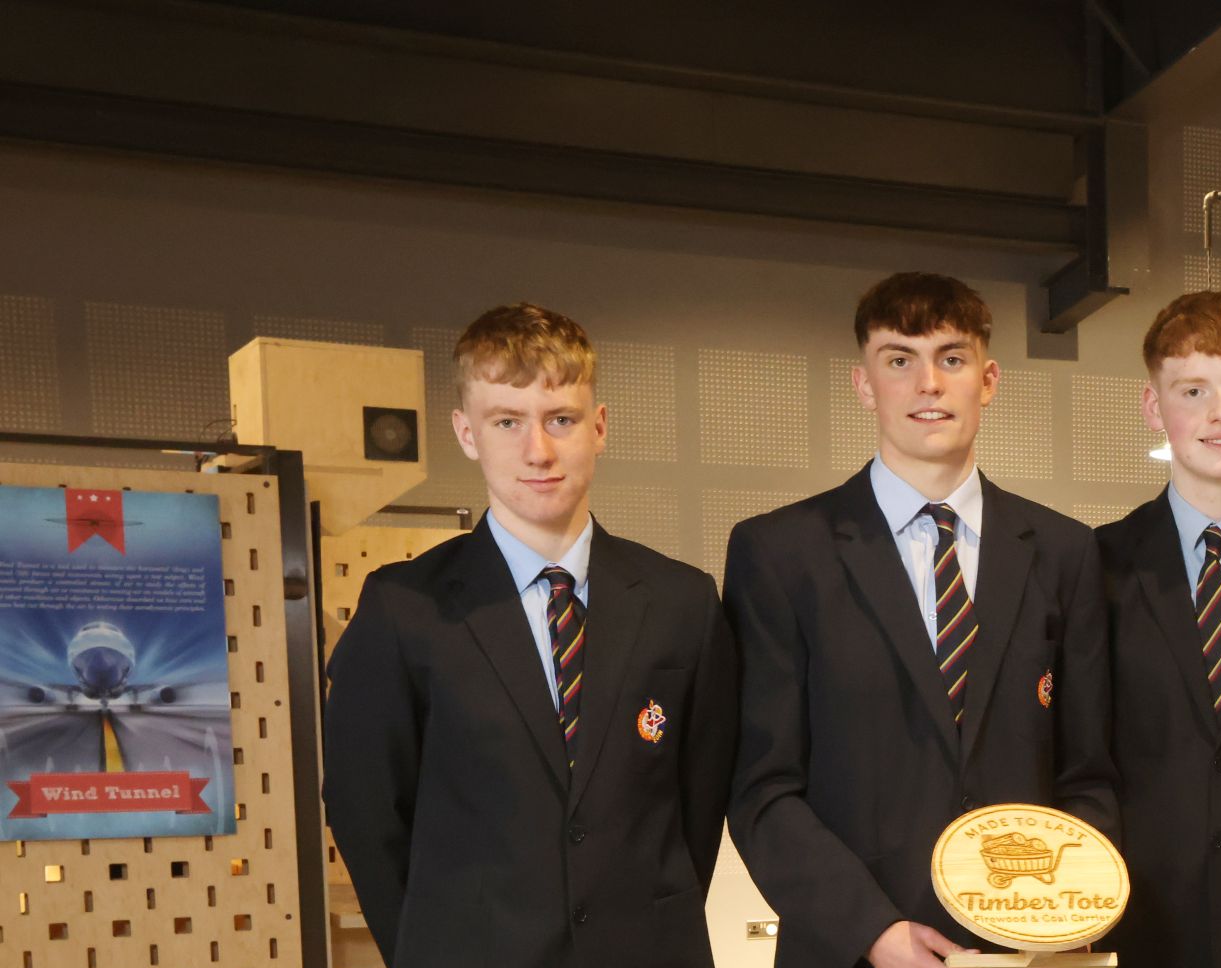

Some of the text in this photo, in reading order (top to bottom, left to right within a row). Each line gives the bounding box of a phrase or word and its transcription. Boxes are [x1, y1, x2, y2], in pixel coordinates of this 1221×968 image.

[41, 784, 181, 801] Wind Tunnel
[964, 817, 1087, 840] MADE TO LAST
[957, 891, 1118, 911] Timber Tote
[973, 913, 1112, 924] Firewood & Coal Carrier
